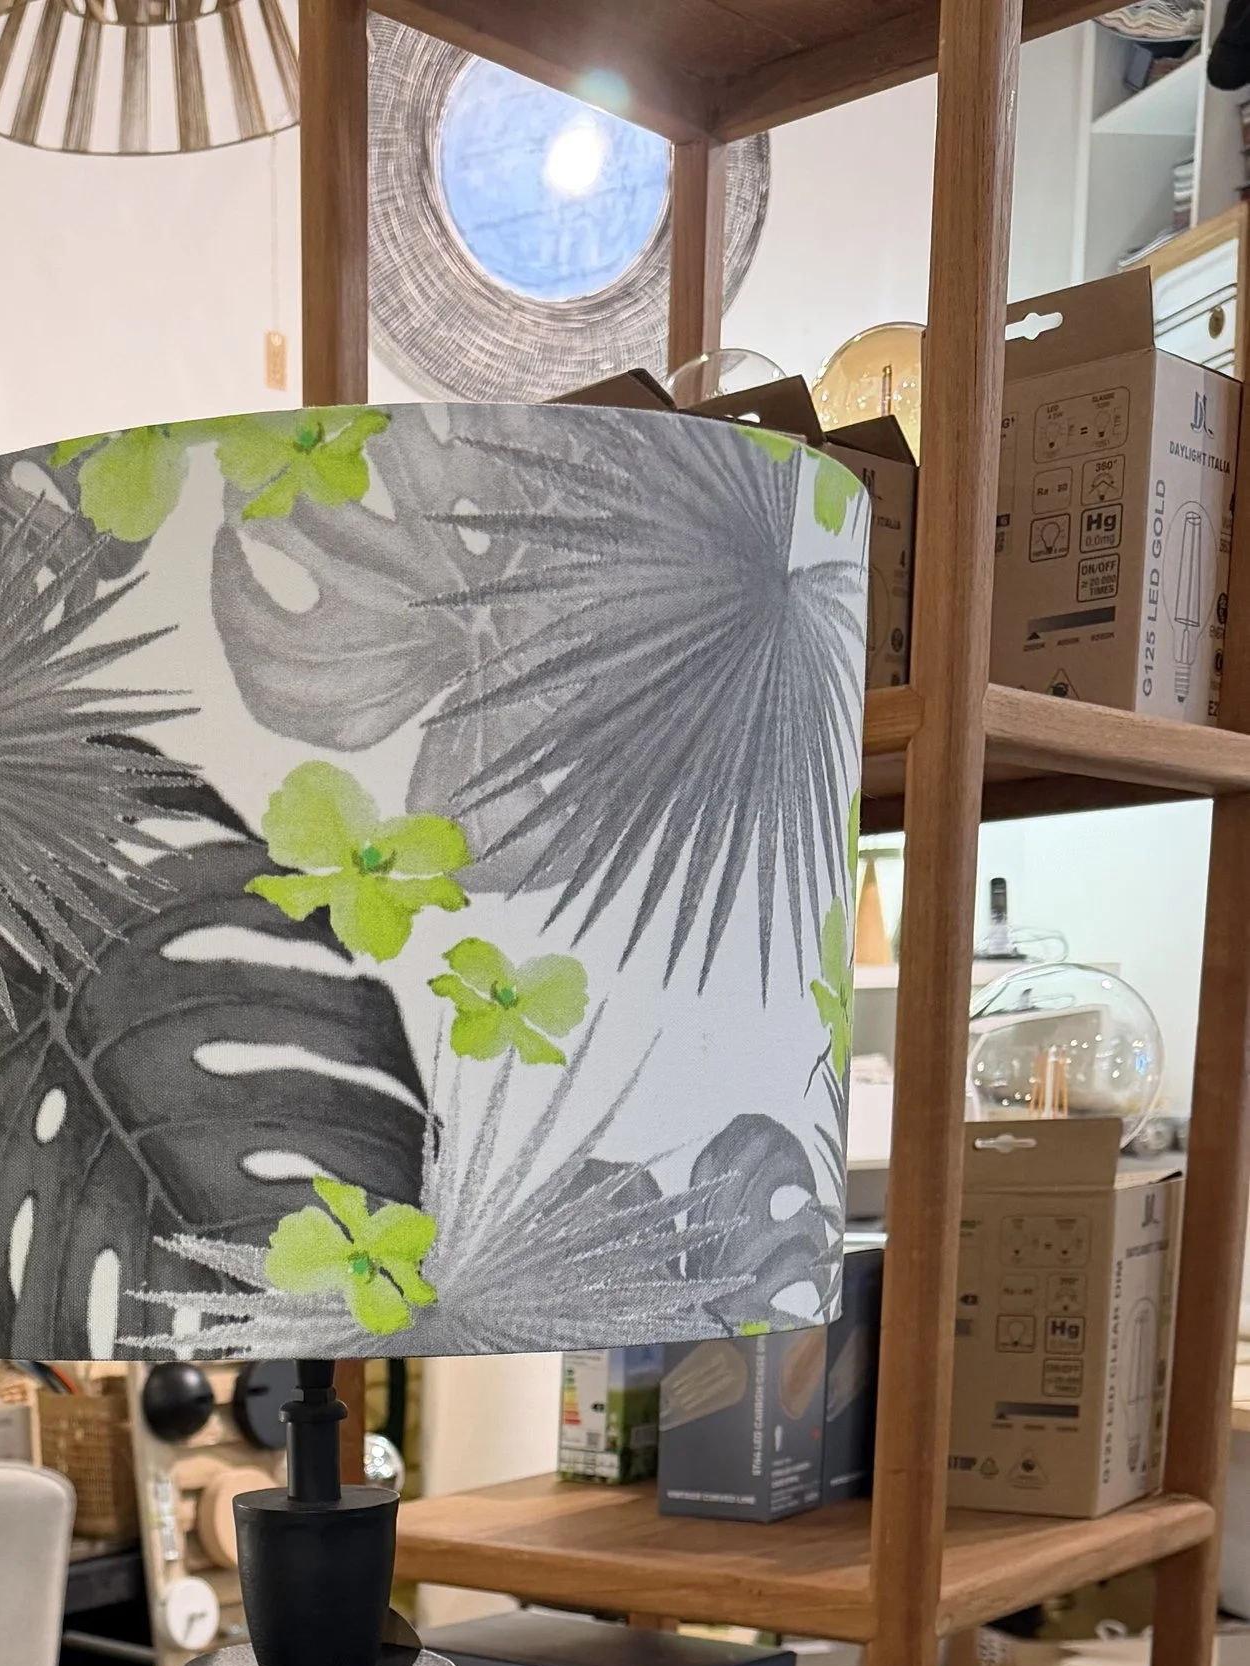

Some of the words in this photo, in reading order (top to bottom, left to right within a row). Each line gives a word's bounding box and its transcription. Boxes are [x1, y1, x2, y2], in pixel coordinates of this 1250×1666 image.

[1169, 440, 1207, 467] DAYLIGHT
[1207, 456, 1231, 474] ITALIA
[1086, 513, 1117, 532] Hg
[1151, 479, 1166, 559] GOLD
[1081, 560, 1117, 576] ON/OFF
[1089, 585, 1115, 597] TIMES
[1147, 568, 1160, 622] LED
[1142, 631, 1156, 697] G125
[1051, 1319, 1080, 1339] Hg
[753, 1429, 764, 1451] LED
